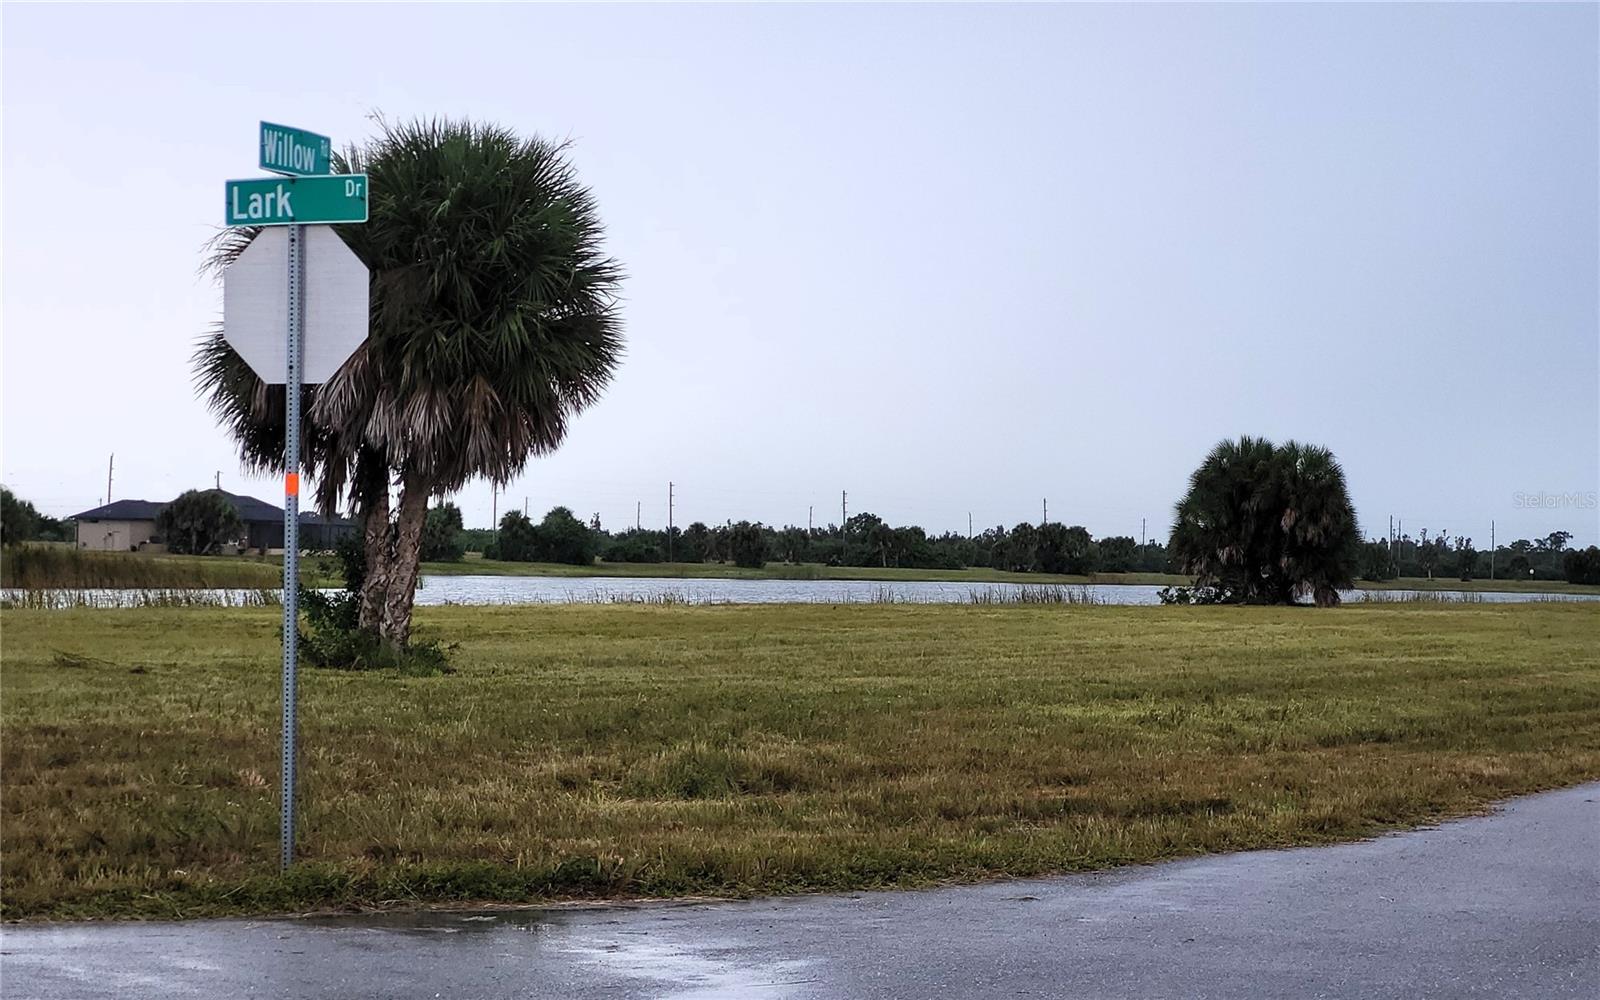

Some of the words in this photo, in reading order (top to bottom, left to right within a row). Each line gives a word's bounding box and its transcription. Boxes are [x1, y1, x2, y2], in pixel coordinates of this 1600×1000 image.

[264, 128, 316, 172] Willow
[232, 184, 294, 220] Lark
[345, 179, 362, 197] Dr
